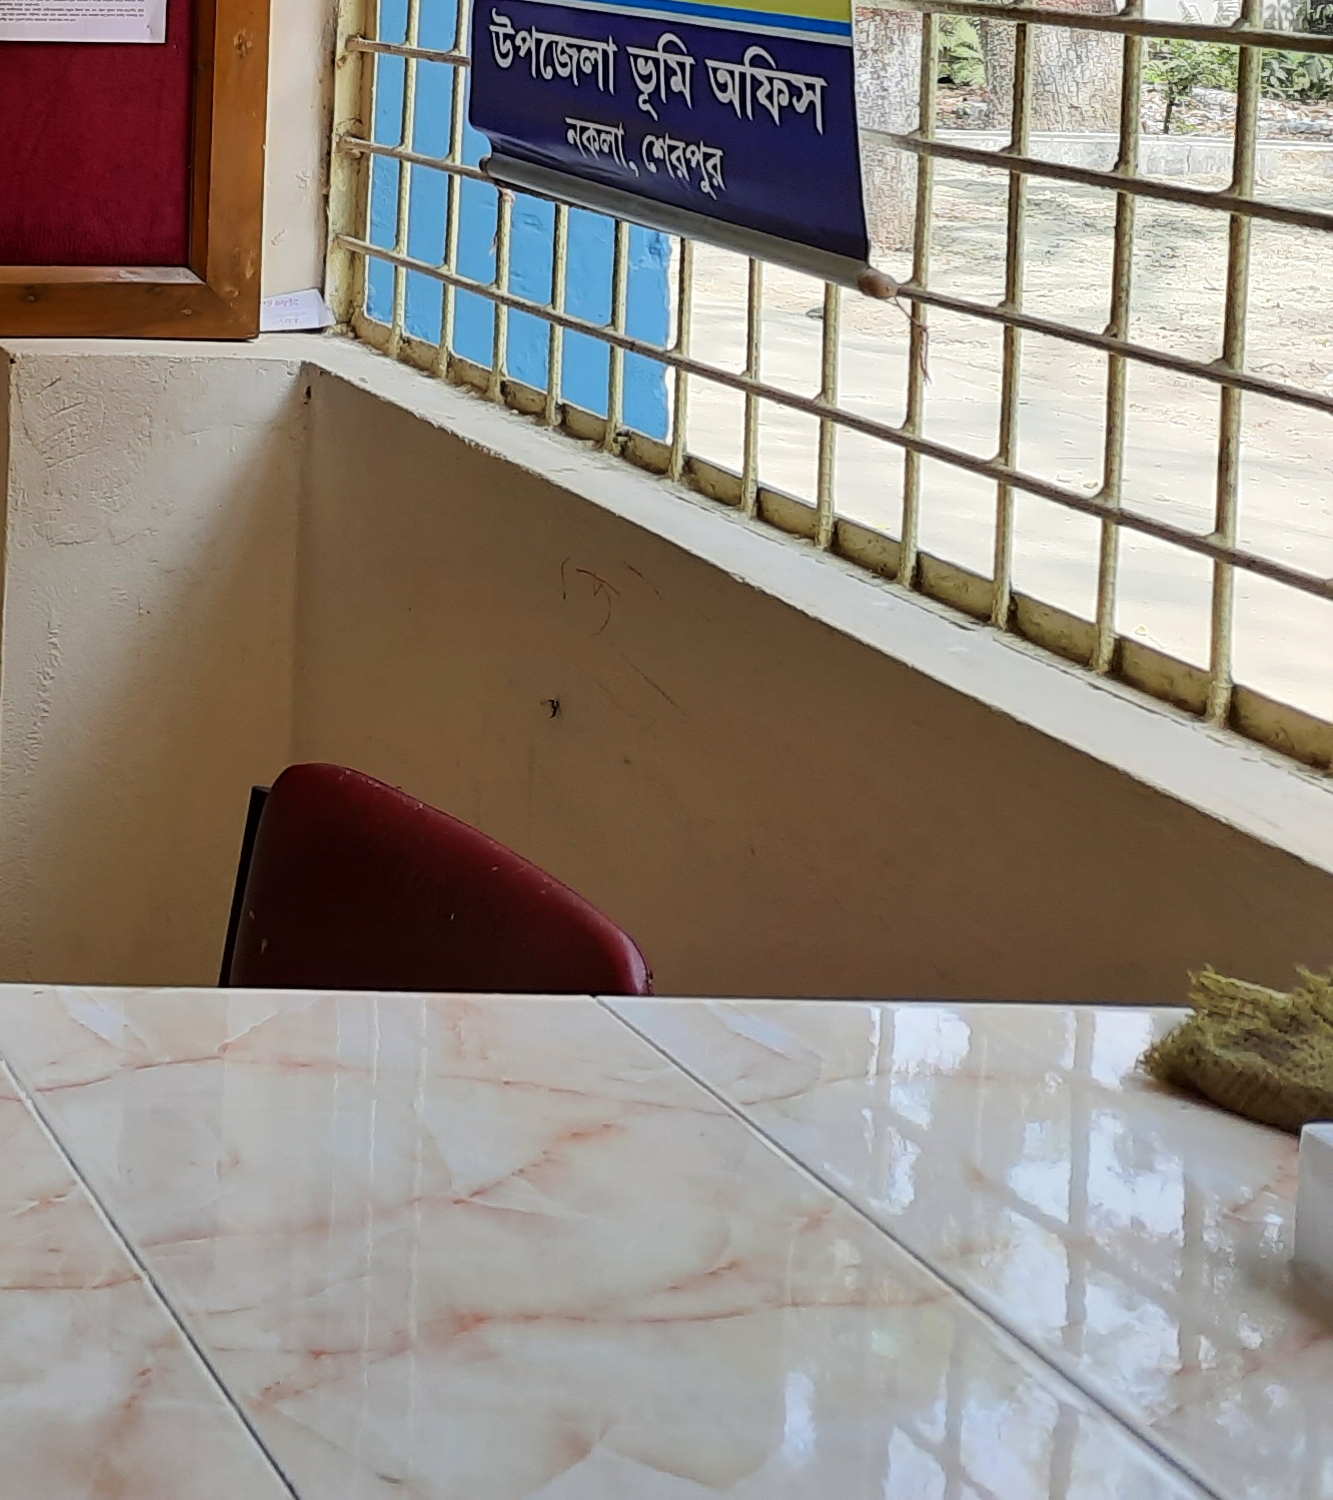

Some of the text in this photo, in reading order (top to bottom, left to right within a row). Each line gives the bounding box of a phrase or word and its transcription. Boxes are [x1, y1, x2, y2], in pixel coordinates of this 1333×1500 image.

[489, 8, 828, 135] উপজেলা ভূমি অফিস
[642, 132, 725, 200] শেরপুর
